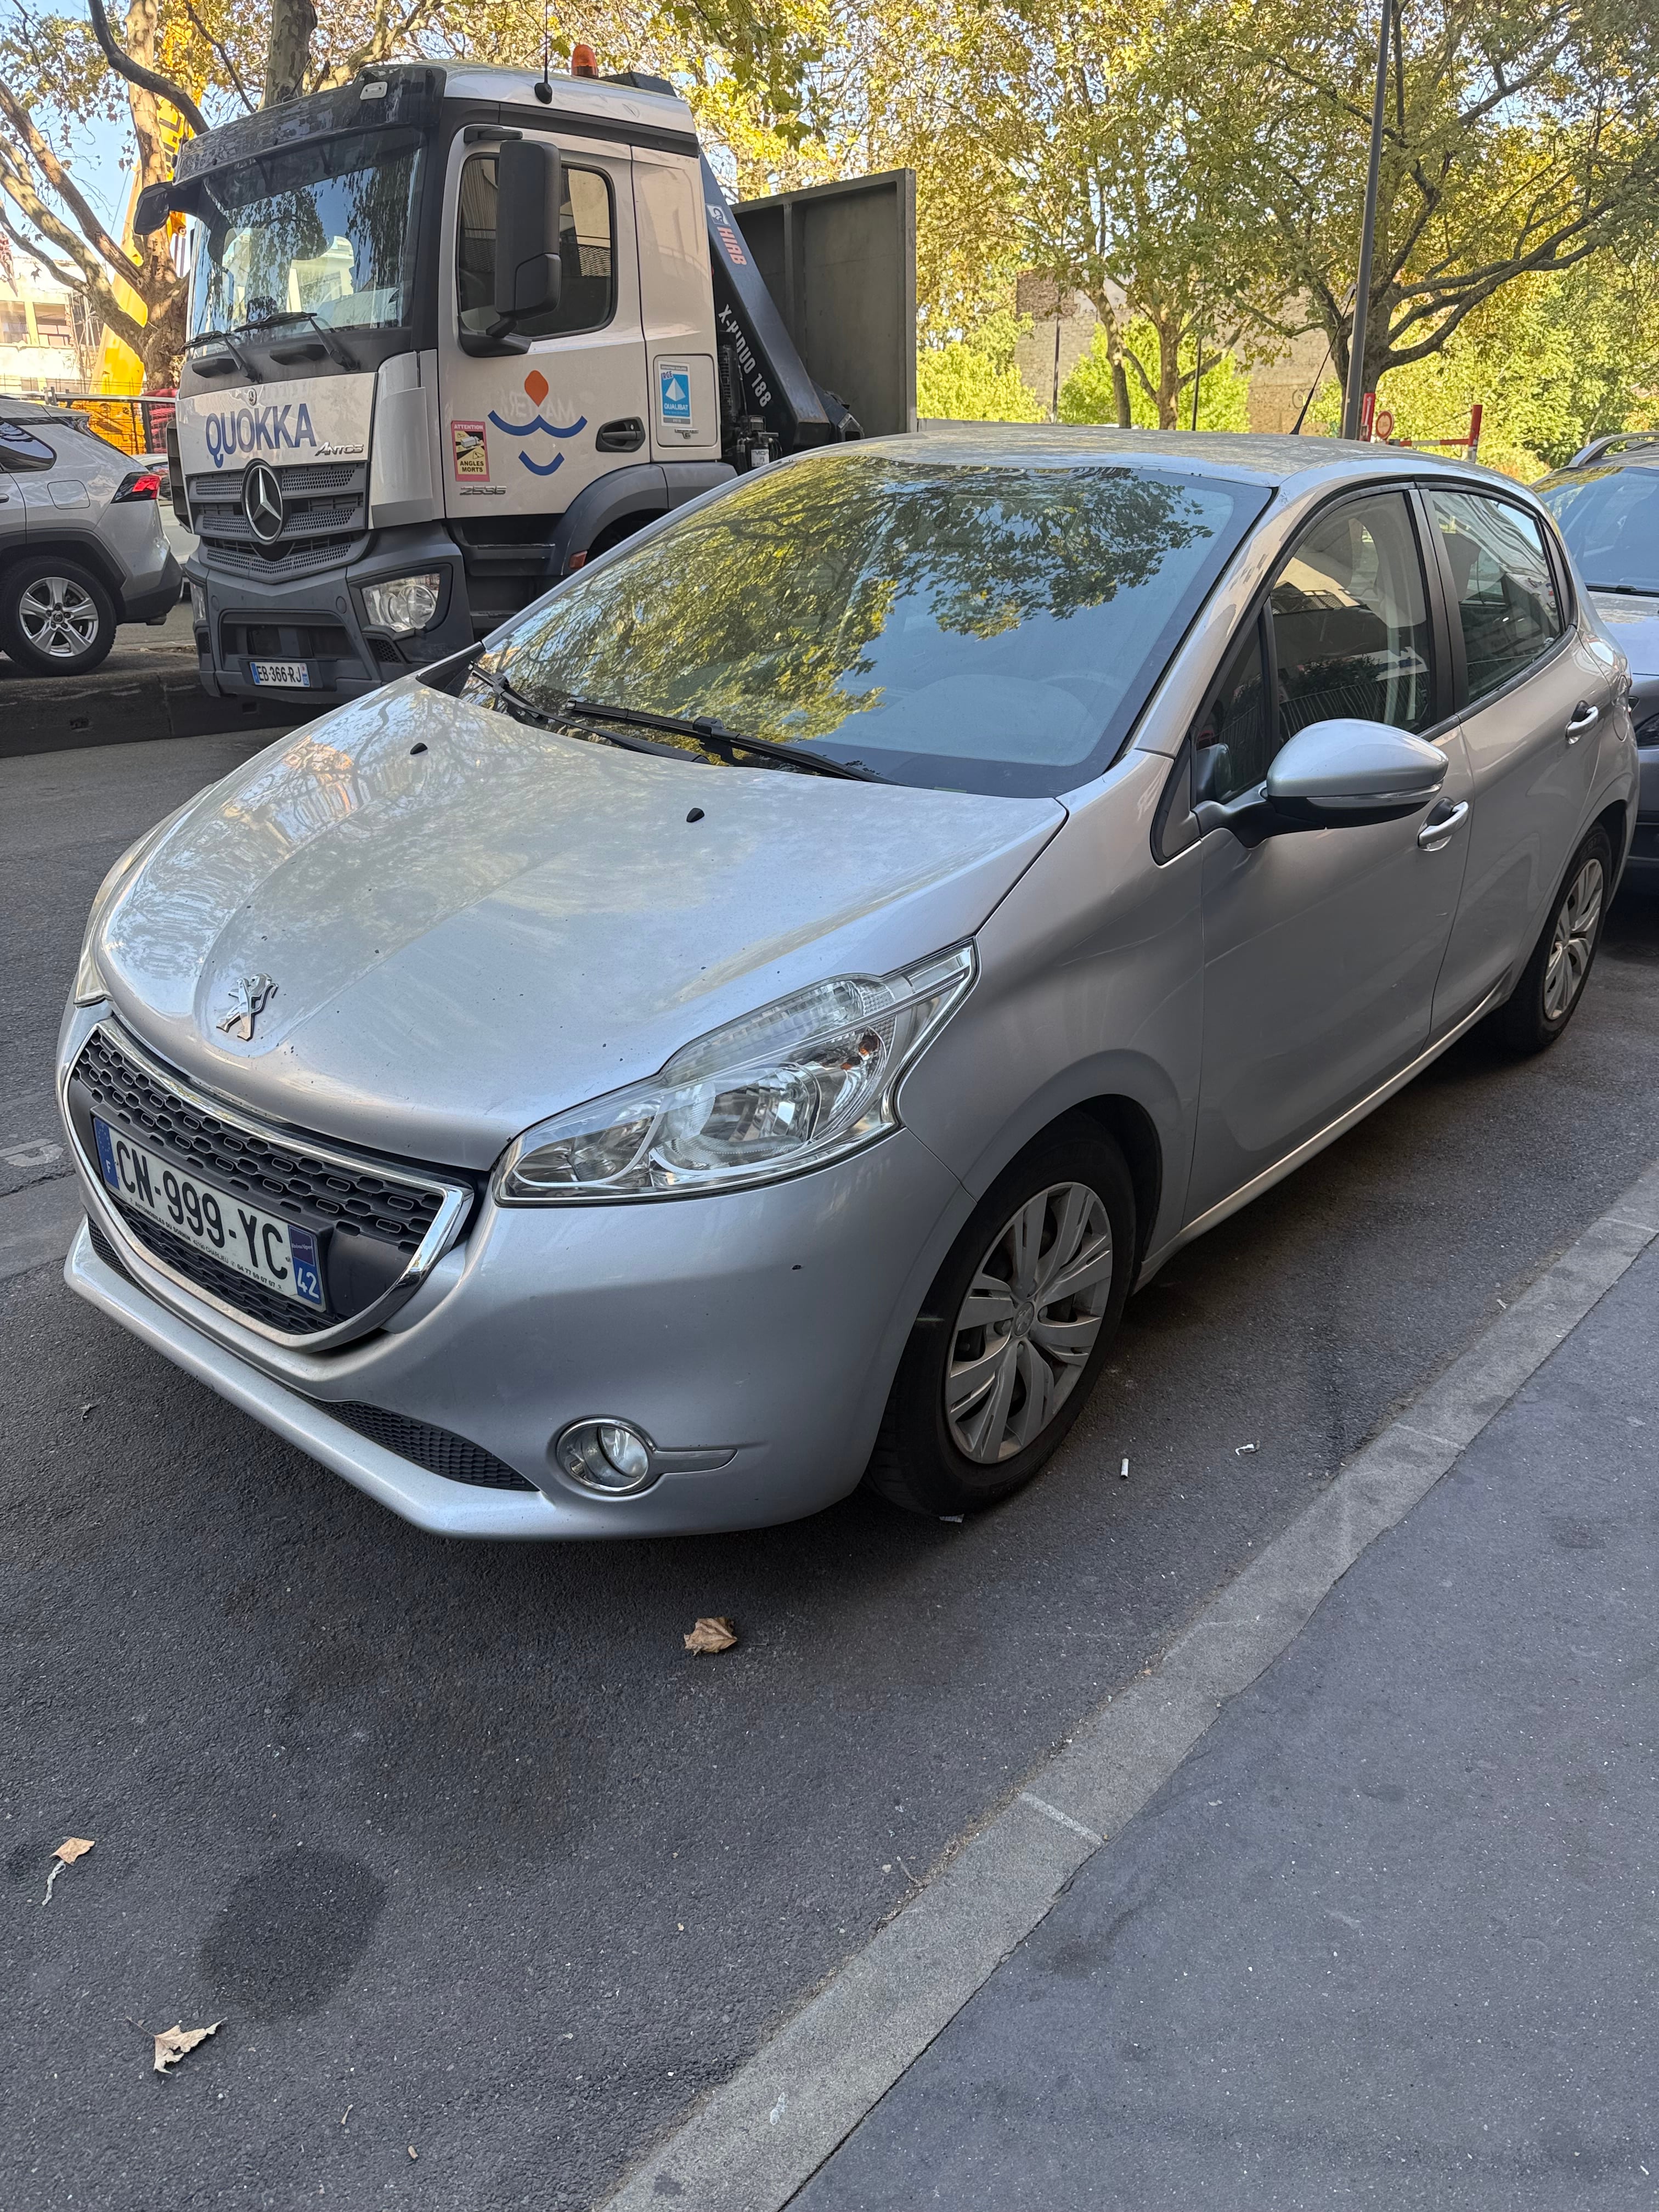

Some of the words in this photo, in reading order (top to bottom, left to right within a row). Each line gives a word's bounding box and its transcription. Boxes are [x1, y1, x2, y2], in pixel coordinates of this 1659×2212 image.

[716, 227, 747, 266] HIAB
[751, 373, 771, 408] 188
[664, 403, 689, 411] QUALIBAT
[205, 403, 317, 469] QUOKKA
[256, 665, 302, 683] EB-366-RJ
[105, 1159, 111, 1174] F
[116, 1140, 288, 1280] CN-999-YC
[245, 1267, 252, 1276] 77
[297, 1267, 320, 1299] 42
